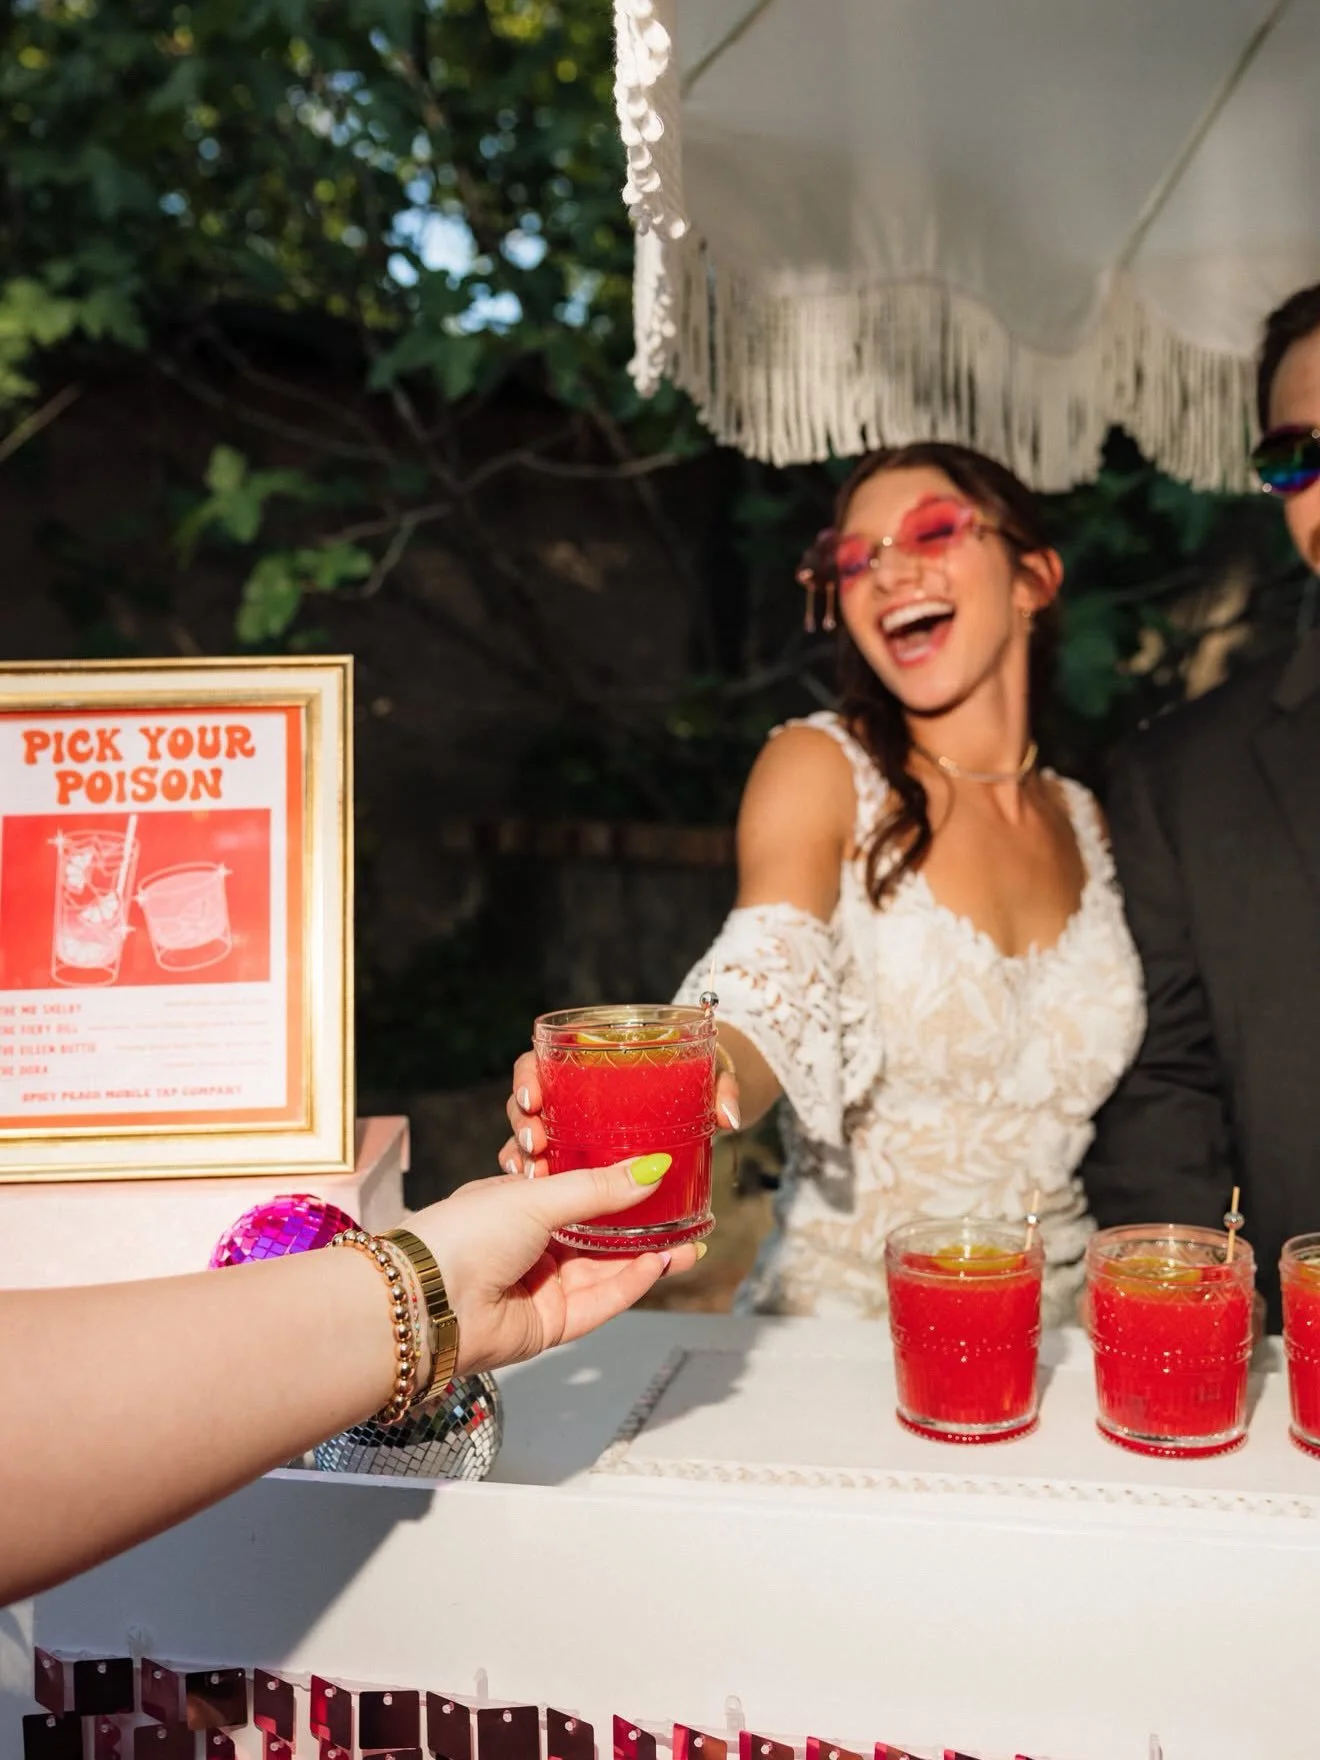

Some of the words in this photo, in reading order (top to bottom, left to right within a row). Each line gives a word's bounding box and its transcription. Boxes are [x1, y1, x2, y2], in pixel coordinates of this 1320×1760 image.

[22, 728, 123, 765] PICK
[139, 725, 256, 761] YOUR
[55, 766, 223, 805] POISON
